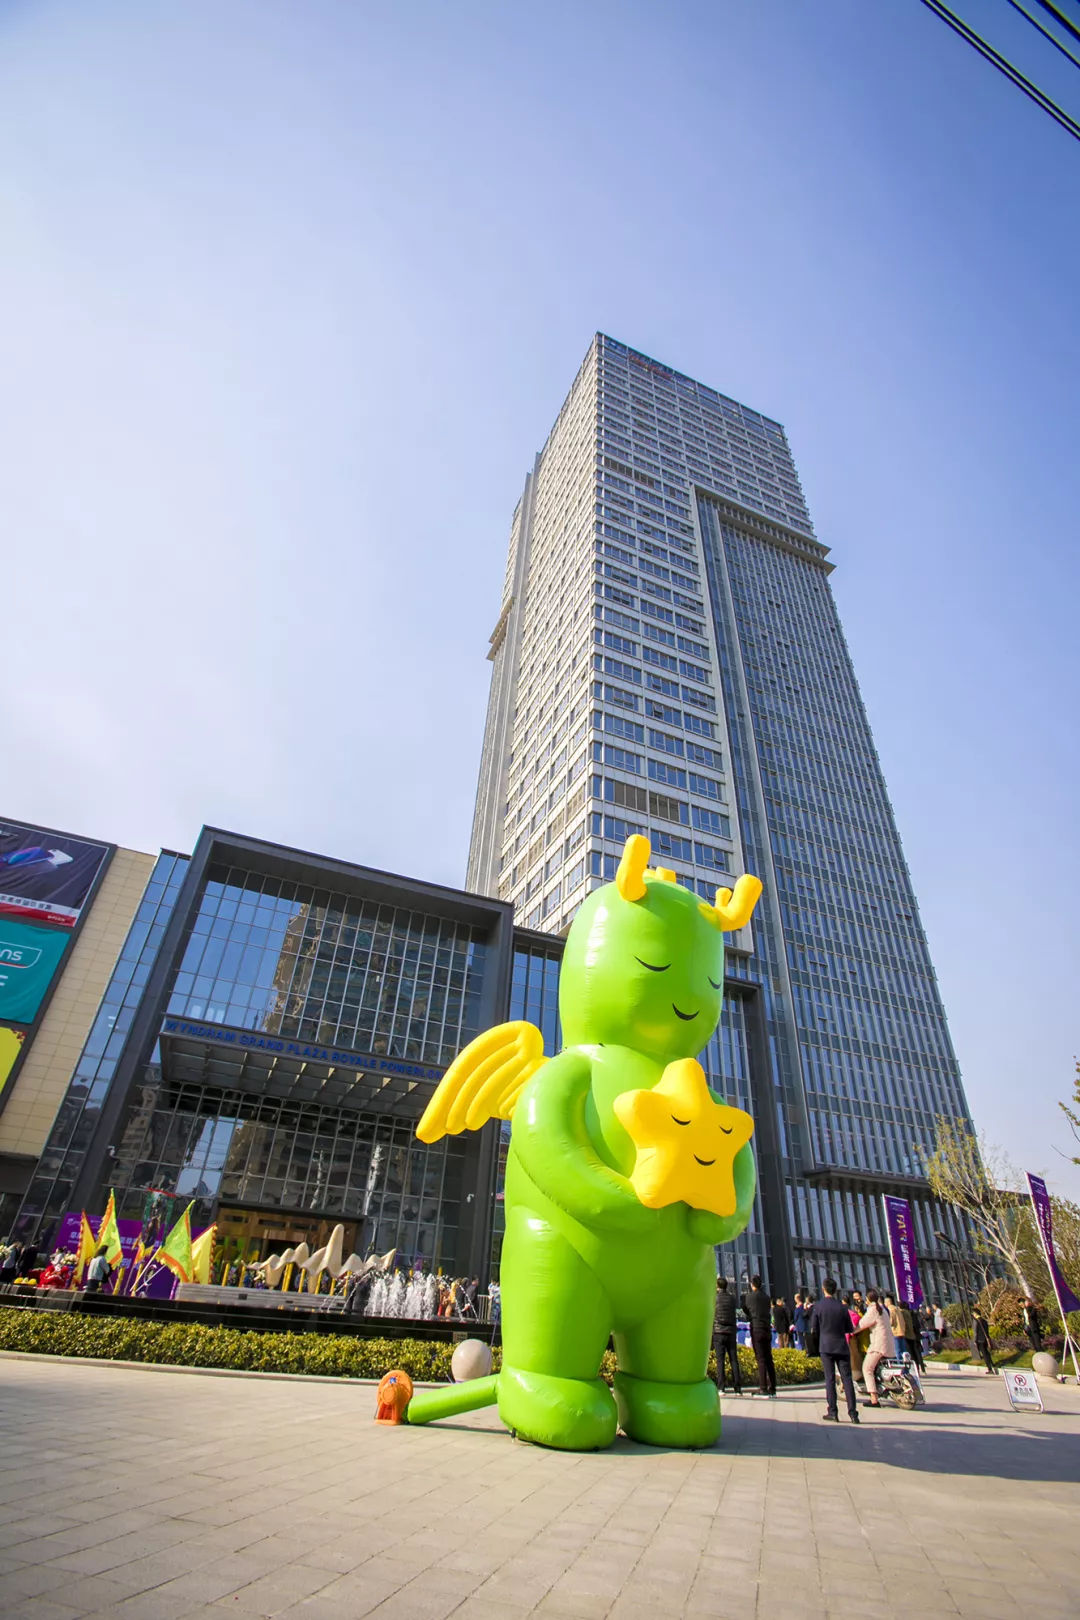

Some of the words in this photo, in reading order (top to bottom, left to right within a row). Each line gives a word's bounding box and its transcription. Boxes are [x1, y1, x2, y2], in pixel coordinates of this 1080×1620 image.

[166, 1020, 236, 1042] WYNDHAM
[239, 1034, 284, 1051] GRAND
[286, 1042, 328, 1060] PLAZA
[331, 1051, 377, 1069] ROYALE
